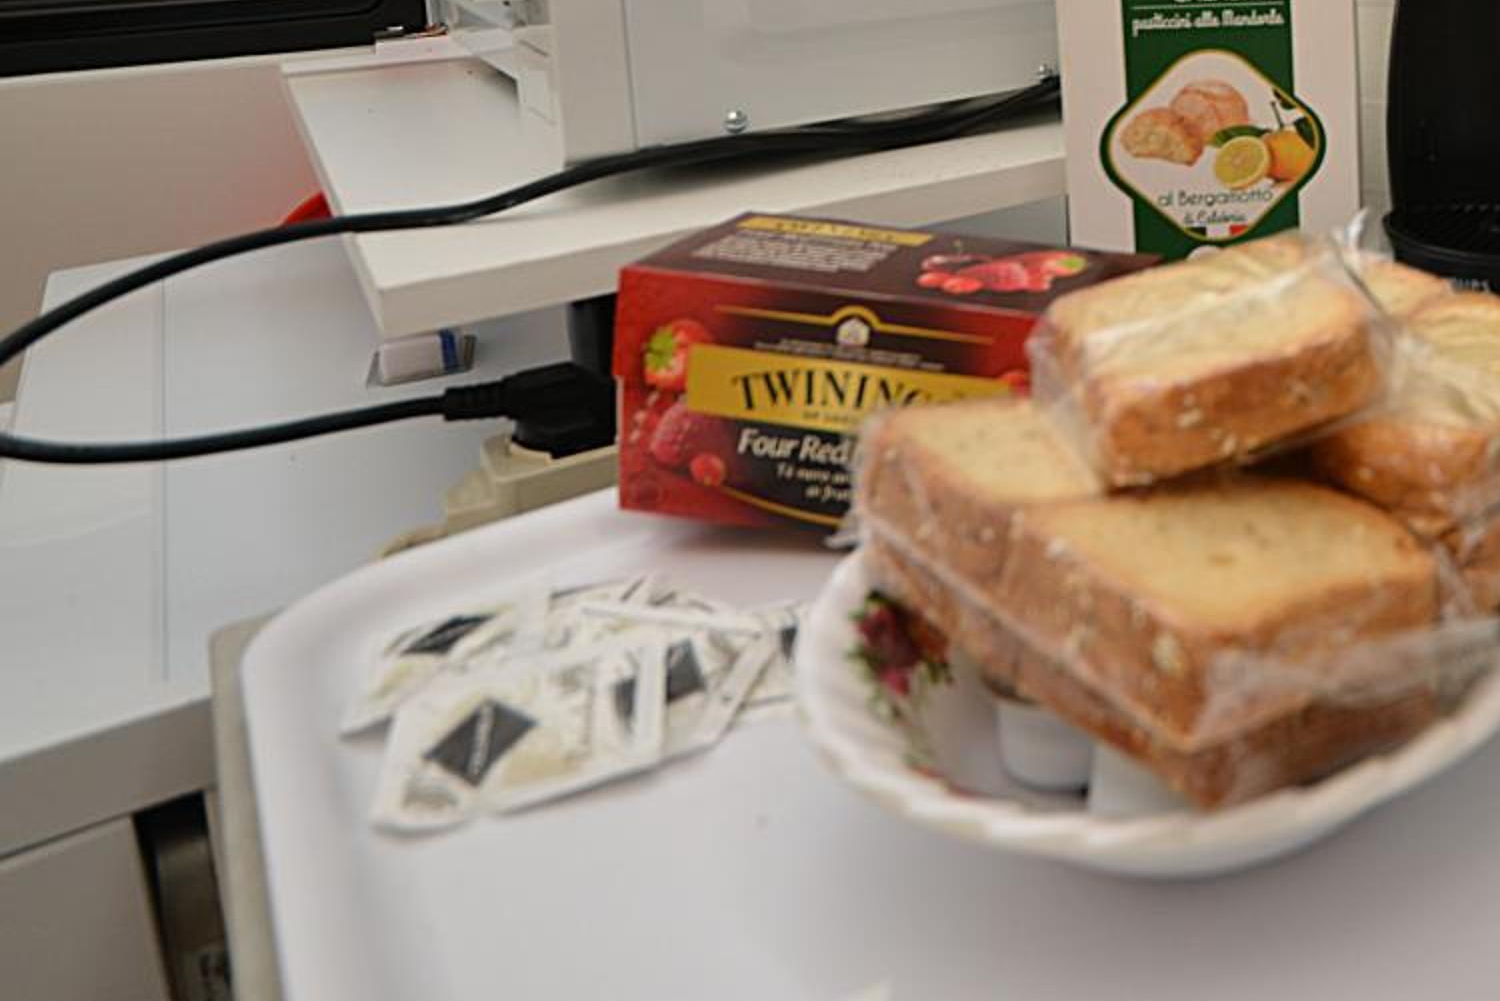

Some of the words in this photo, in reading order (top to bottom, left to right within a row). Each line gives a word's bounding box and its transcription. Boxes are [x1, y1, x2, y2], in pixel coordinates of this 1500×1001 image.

[1177, 187, 1275, 209] Bergamotto
[736, 428, 801, 458] Four
[798, 434, 851, 464] Red
